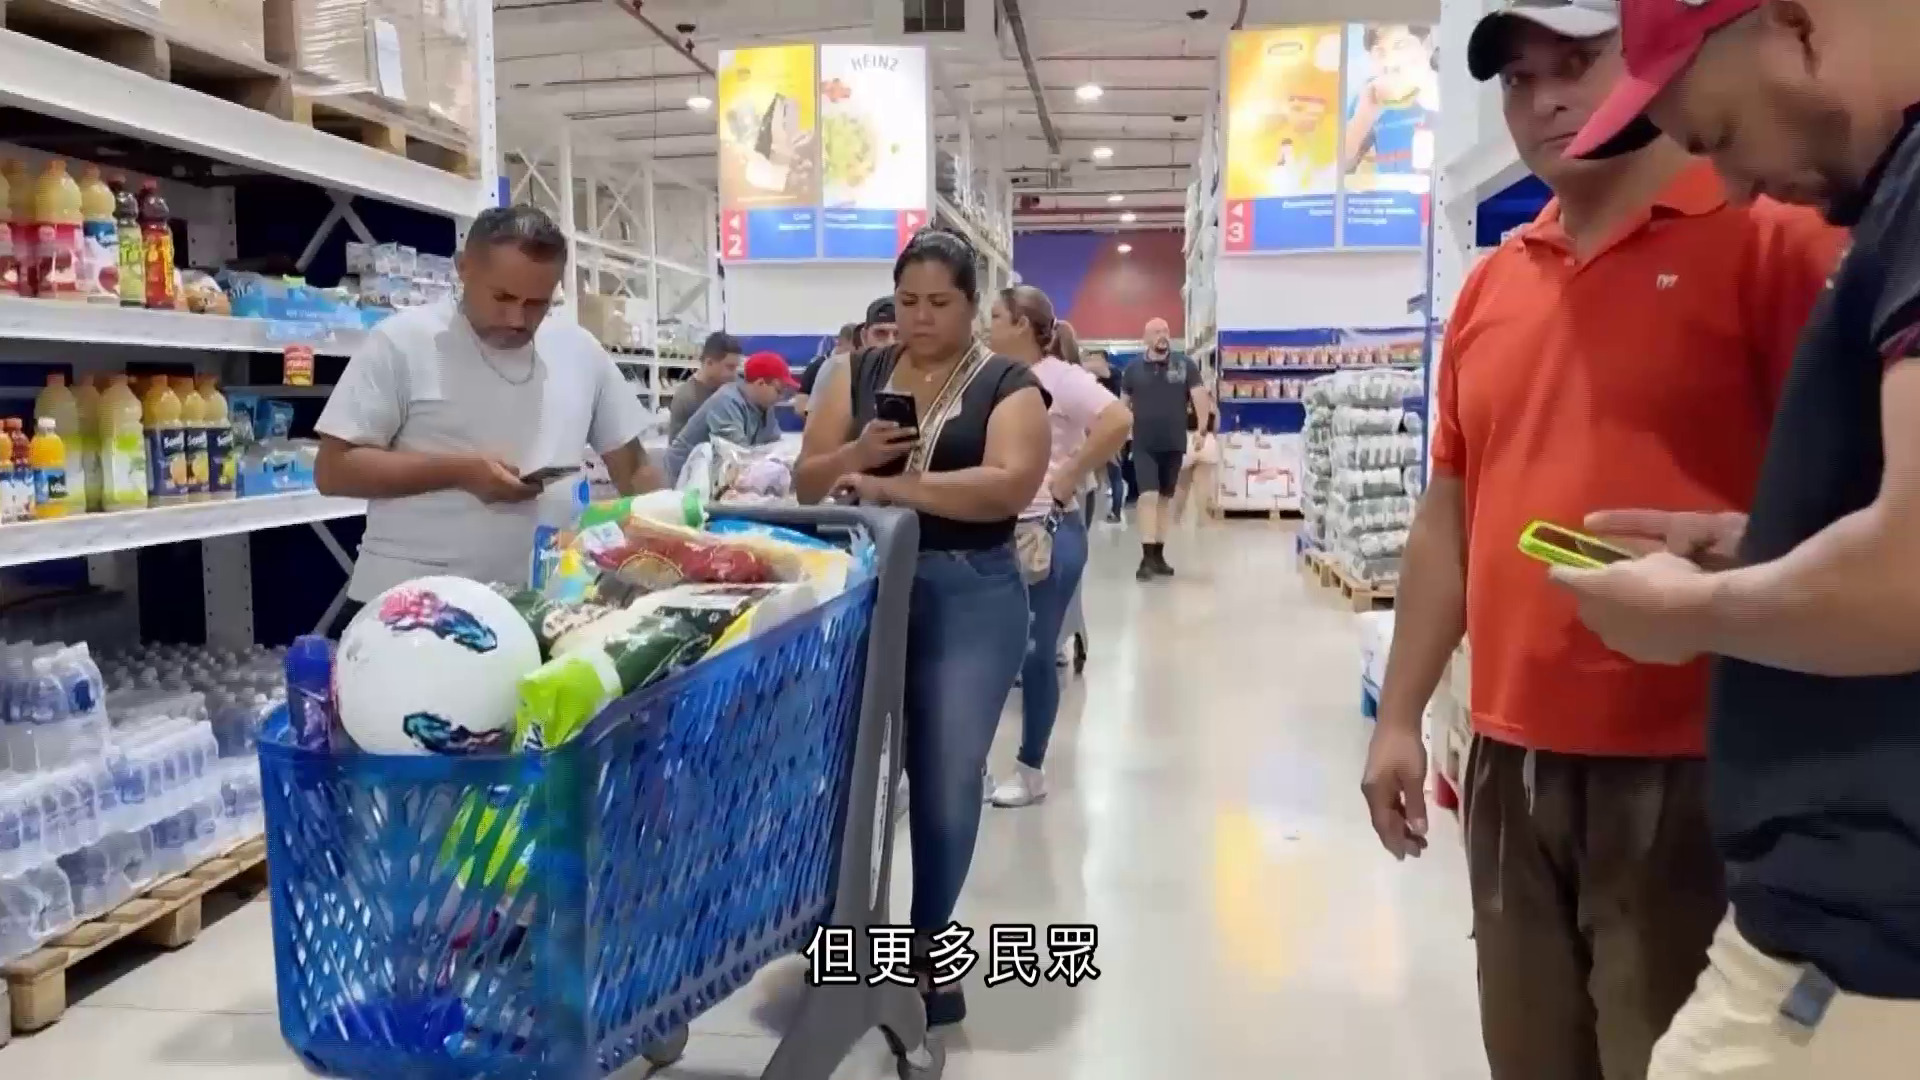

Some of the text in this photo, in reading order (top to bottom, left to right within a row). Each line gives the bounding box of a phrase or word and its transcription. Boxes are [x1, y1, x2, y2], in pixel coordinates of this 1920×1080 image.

[850, 53, 899, 72] HEINZ
[1228, 221, 1245, 243] 3
[728, 234, 743, 256] 2
